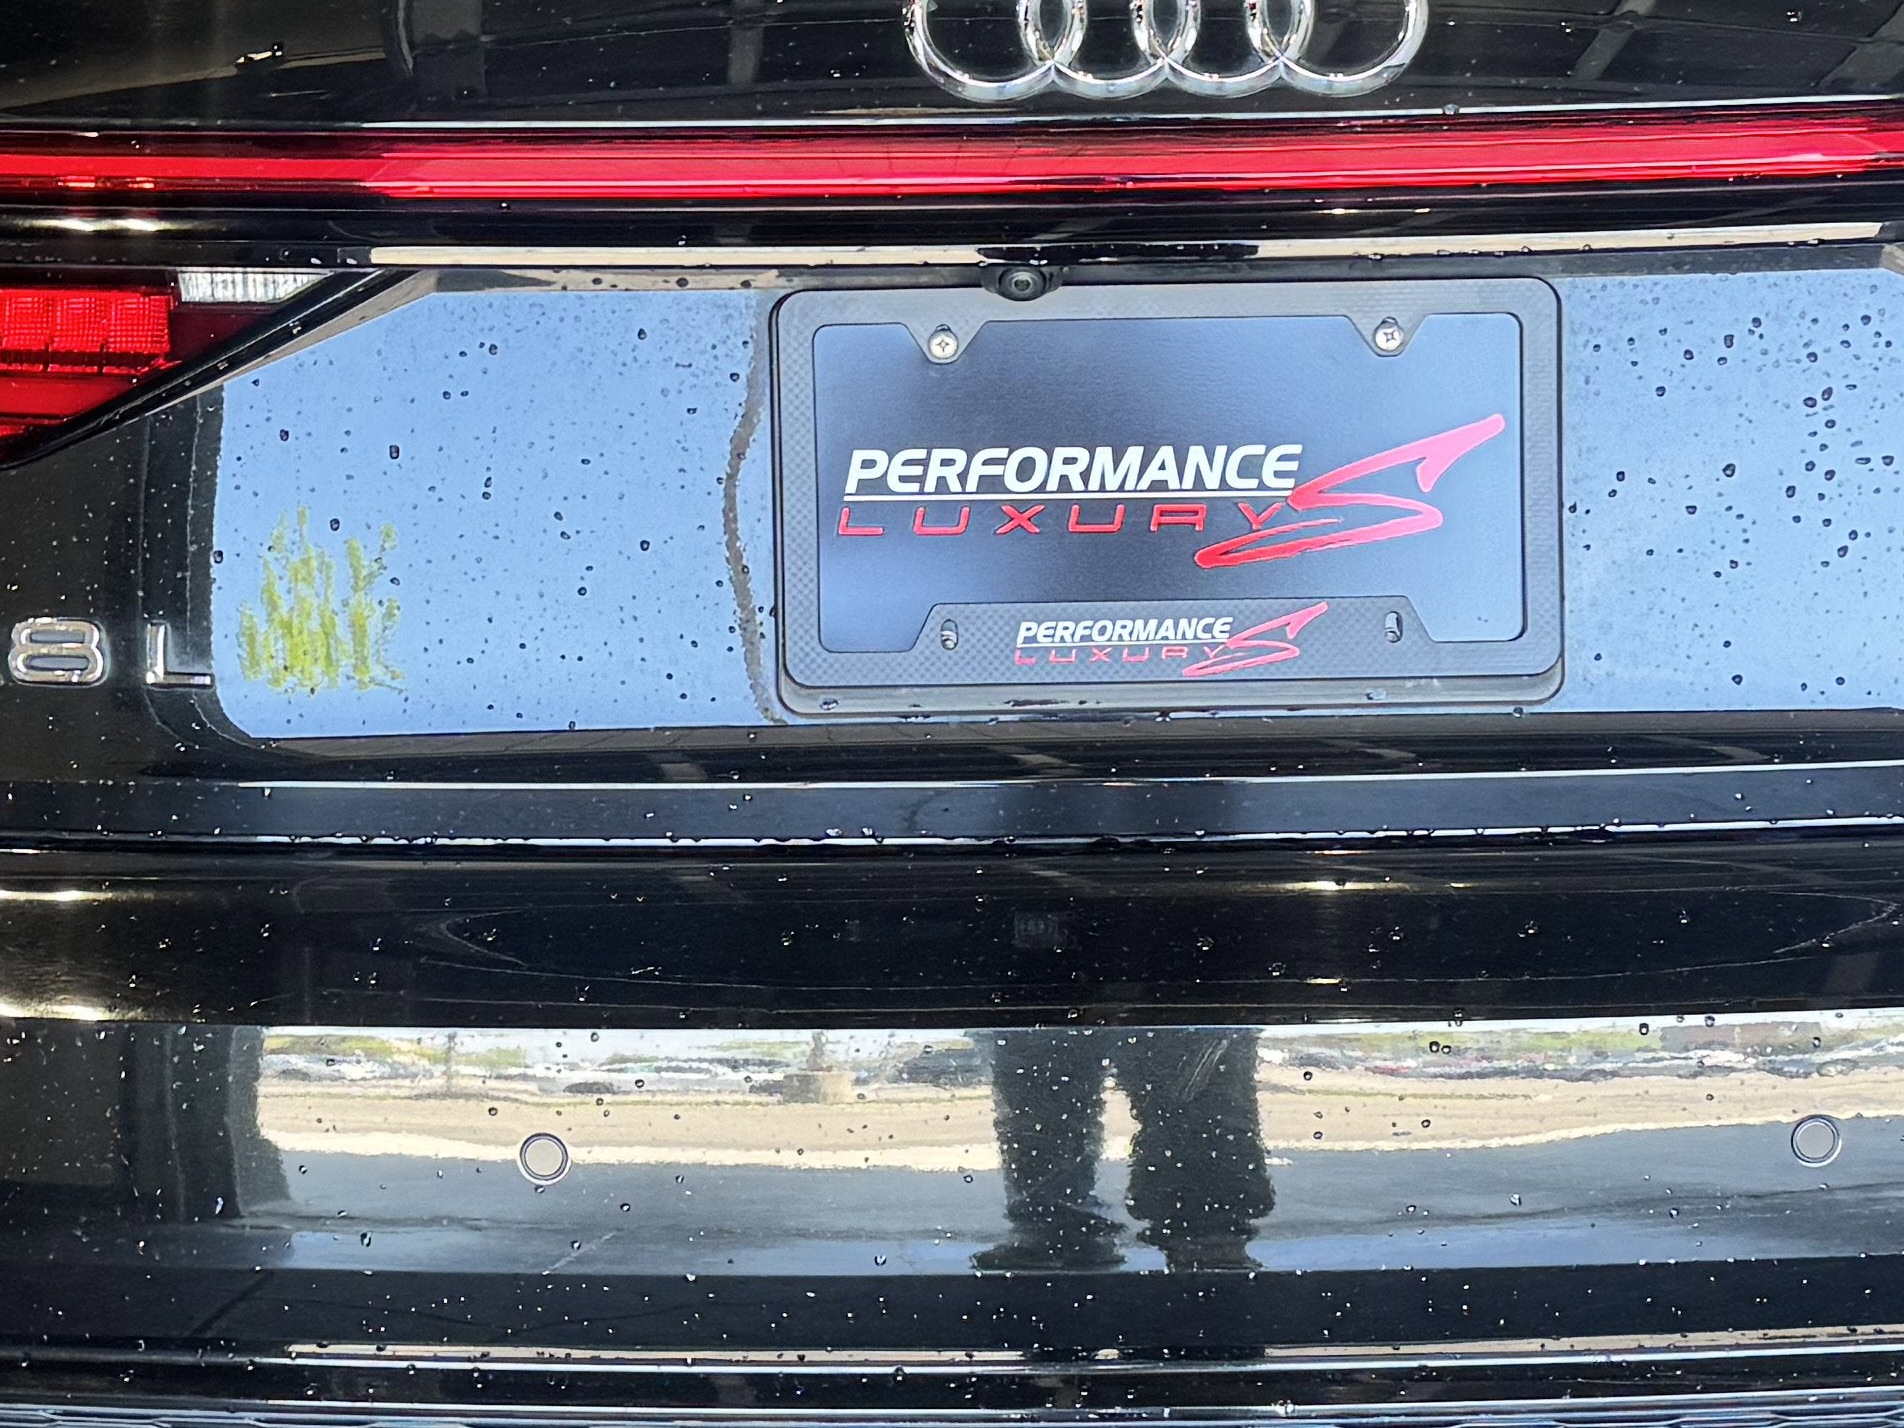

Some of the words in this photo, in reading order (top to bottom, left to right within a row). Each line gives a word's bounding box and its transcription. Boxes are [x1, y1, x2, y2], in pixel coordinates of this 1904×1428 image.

[844, 443, 1303, 495] PERFORMANCE
[837, 500, 1287, 536] LUXURY
[1016, 616, 1234, 645] PERFORMANCE
[143, 619, 215, 689] L
[1013, 643, 1227, 666] LUXURY
